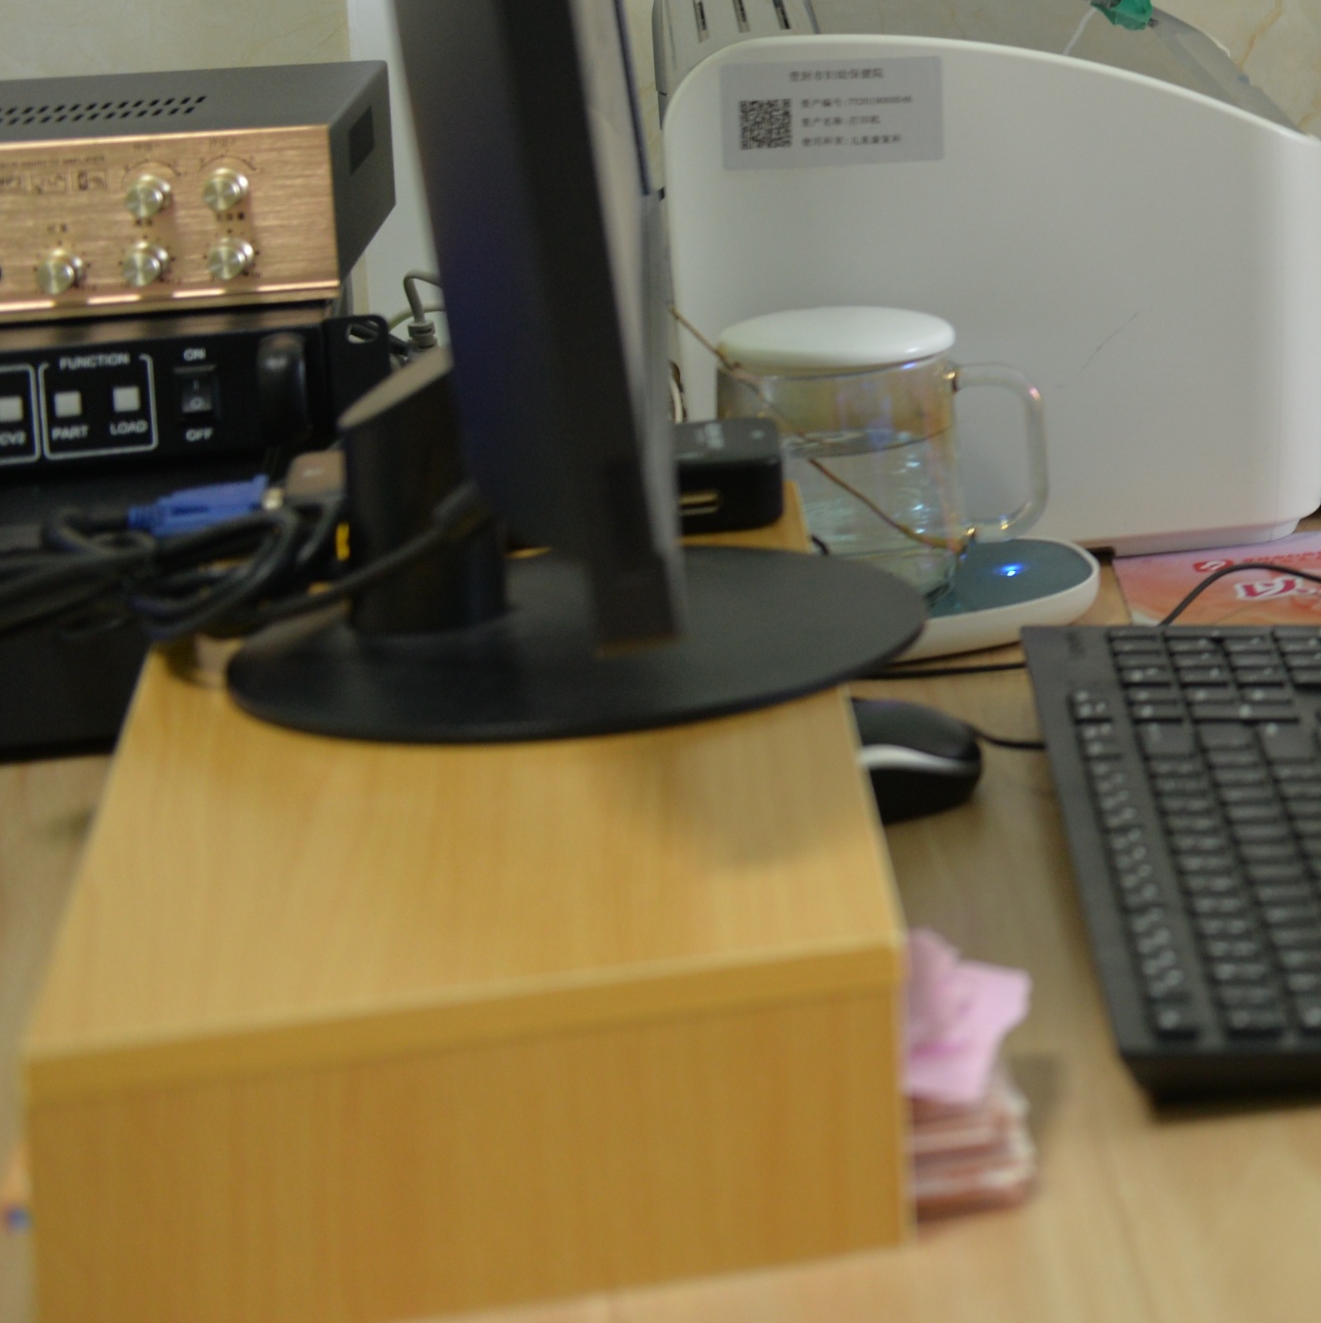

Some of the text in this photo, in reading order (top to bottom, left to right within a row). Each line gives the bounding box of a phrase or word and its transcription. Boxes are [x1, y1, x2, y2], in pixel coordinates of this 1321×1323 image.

[59, 352, 131, 371] FUNCTION
[183, 348, 206, 362] ON
[51, 424, 89, 441] PART
[110, 420, 148, 436] LOAD
[185, 427, 214, 442] OFF
